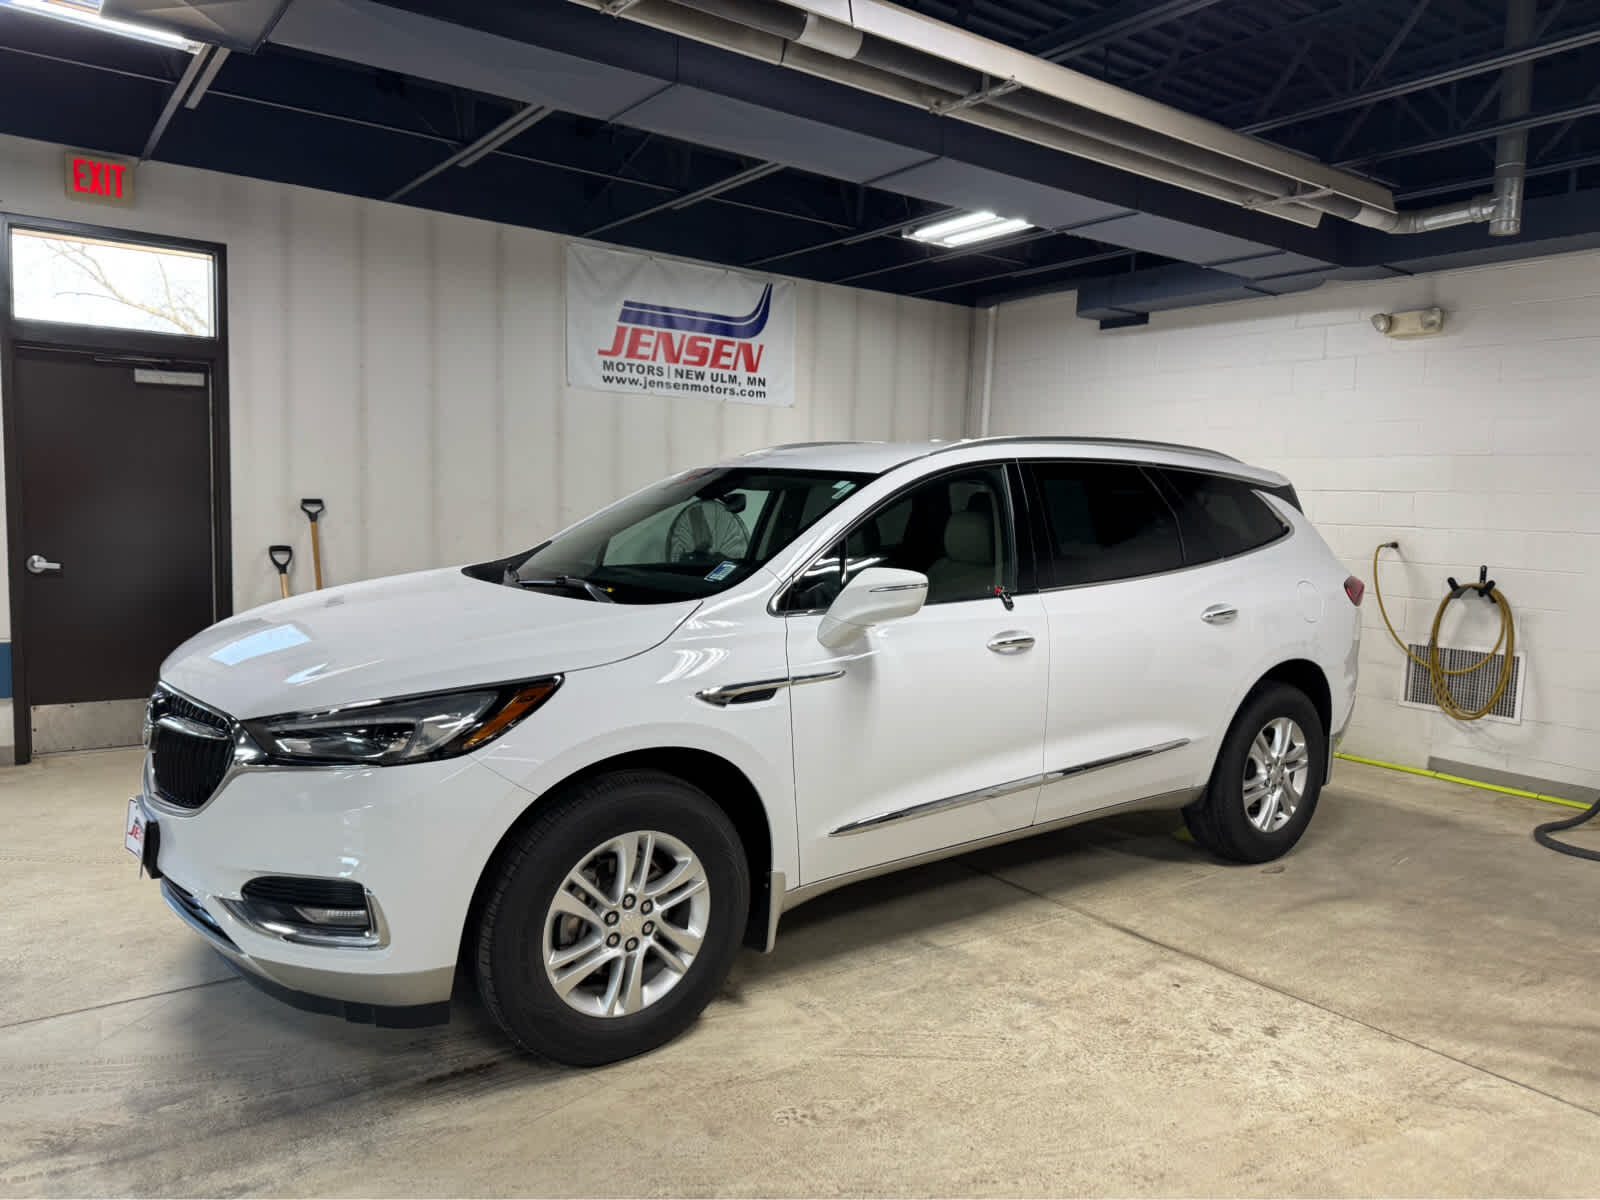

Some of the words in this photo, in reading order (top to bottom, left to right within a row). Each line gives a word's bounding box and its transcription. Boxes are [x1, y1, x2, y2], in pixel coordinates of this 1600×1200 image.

[73, 158, 126, 198] EXIT
[597, 325, 764, 373] JENSEN
[602, 360, 664, 376] MOTORS
[674, 368, 705, 381] NEW
[710, 371, 741, 386] ULM,
[746, 376, 766, 387] MN
[602, 373, 766, 398] www.jensenmotors.com
